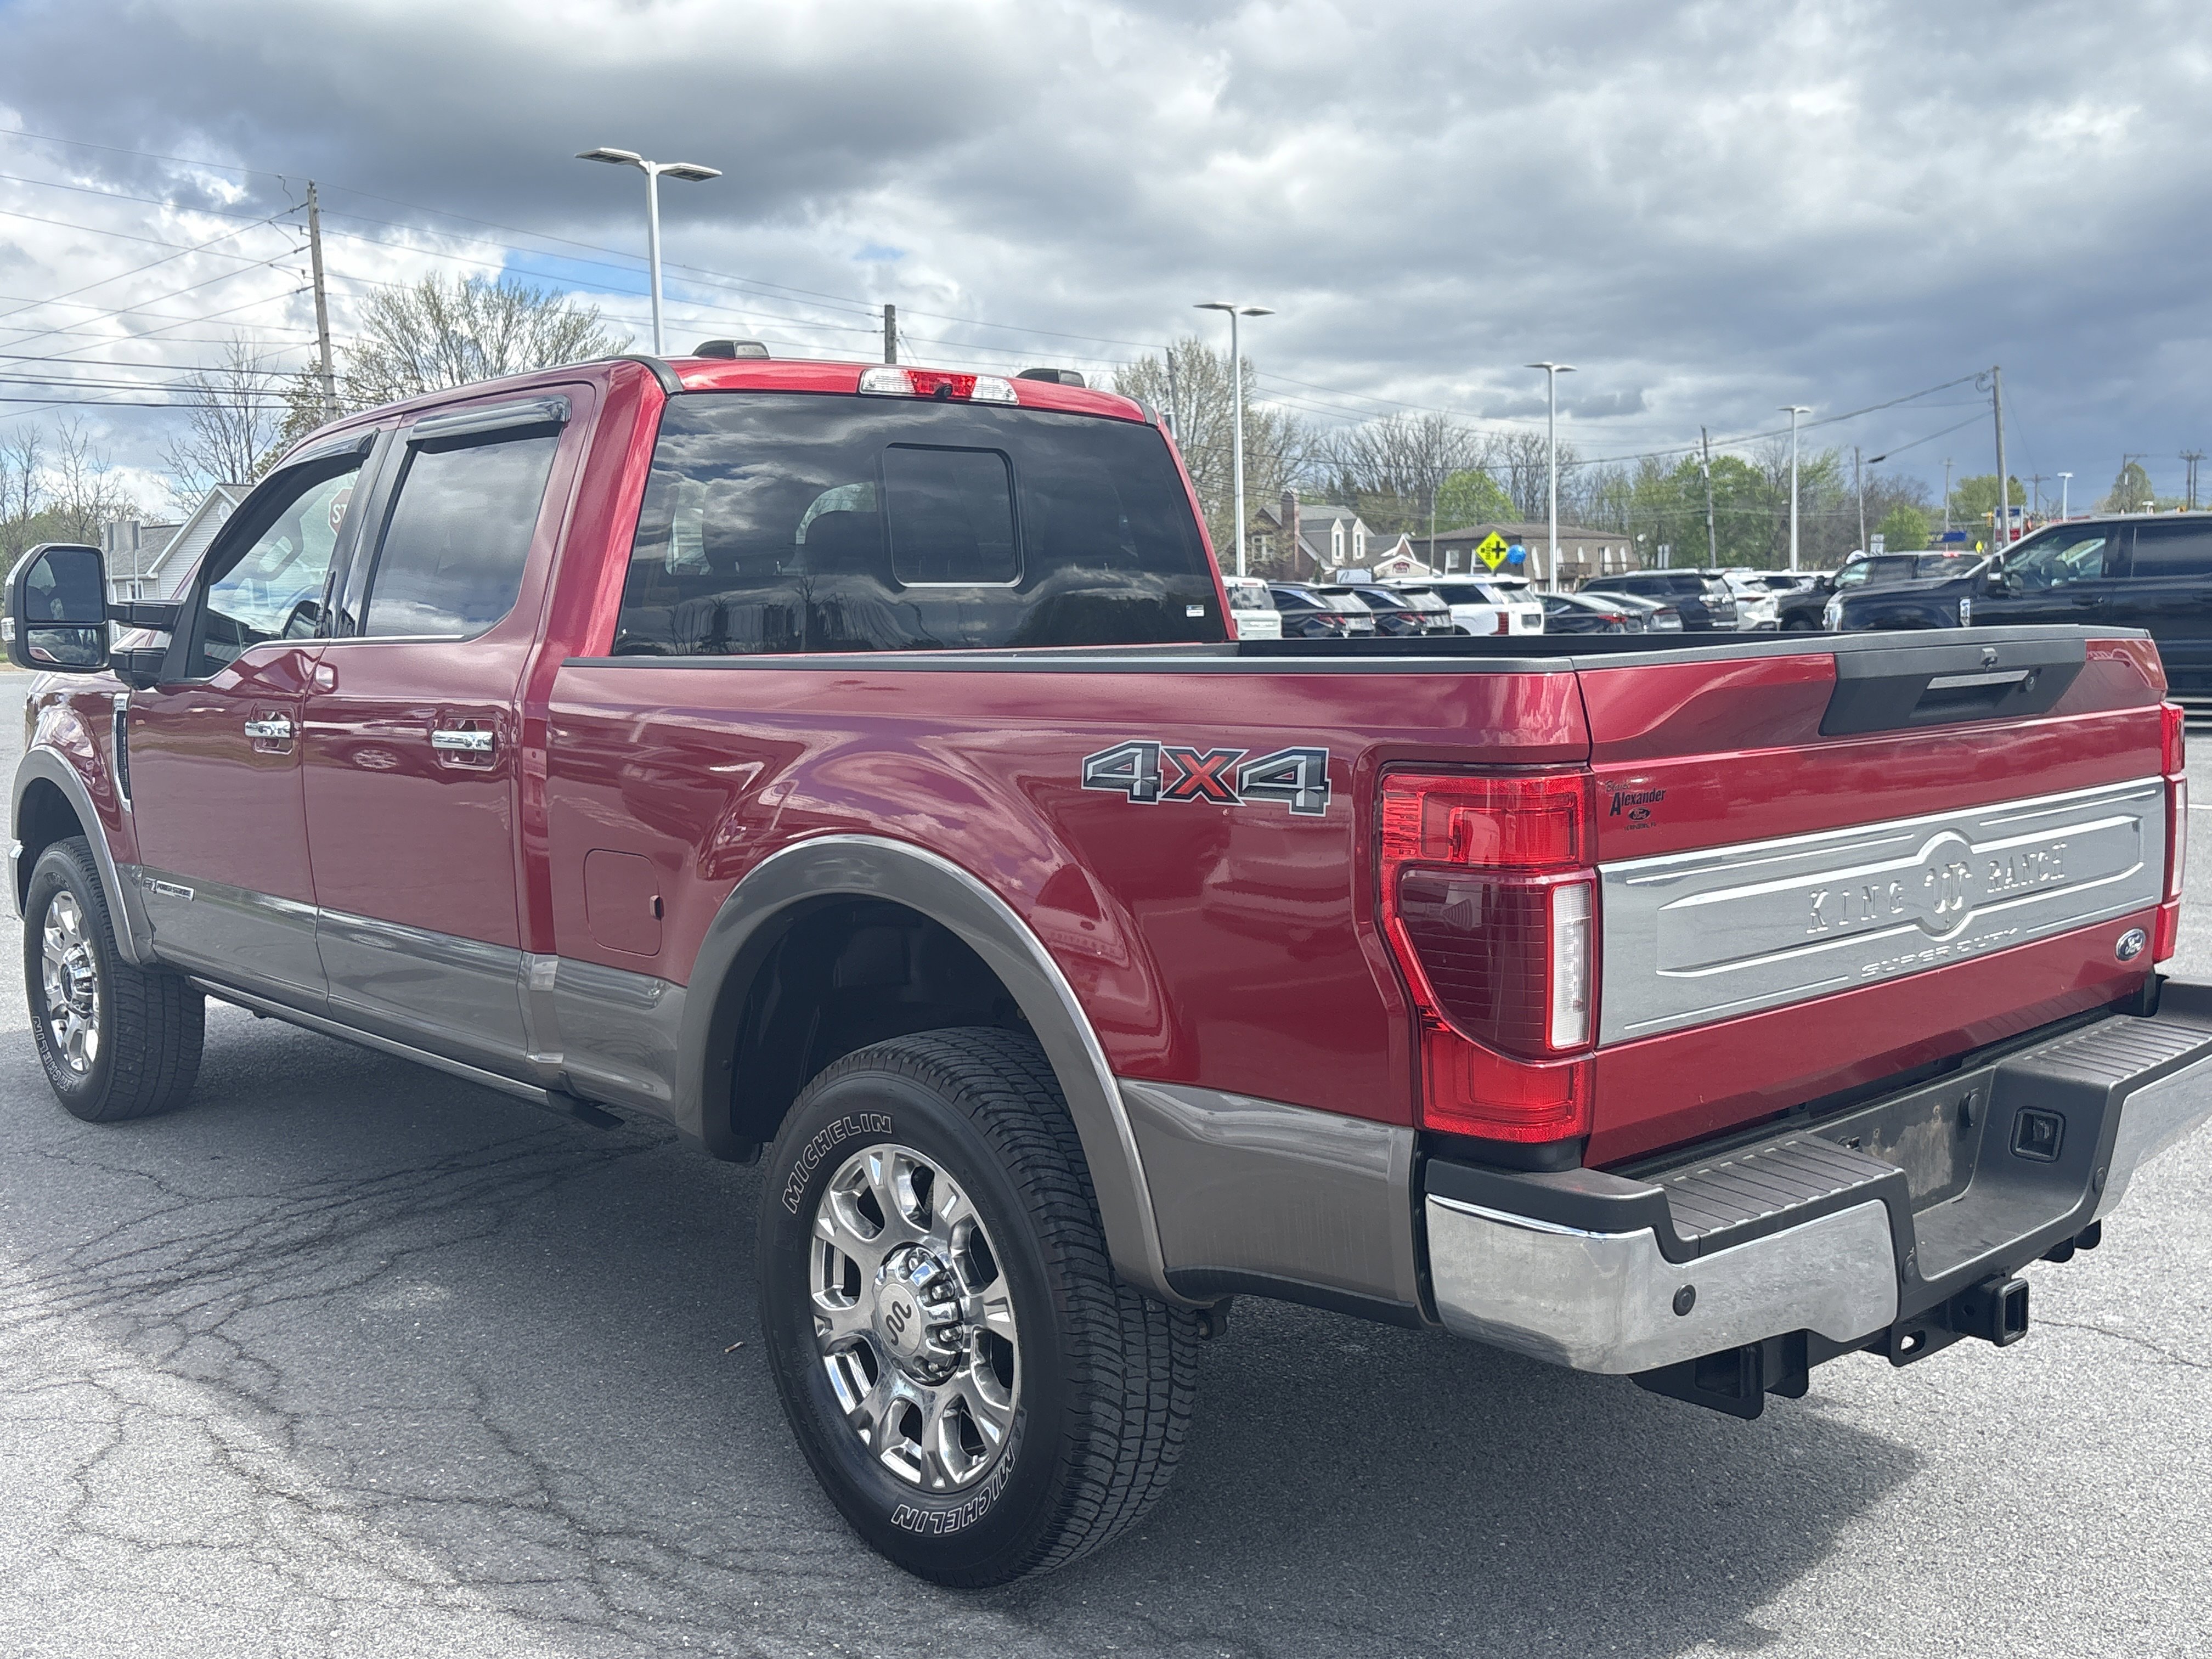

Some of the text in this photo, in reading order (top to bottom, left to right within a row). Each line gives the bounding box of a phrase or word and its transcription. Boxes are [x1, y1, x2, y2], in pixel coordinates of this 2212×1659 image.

[1609, 787, 1667, 817] Alexander
[1806, 842, 2068, 934] KING RANCH
[1861, 927, 2018, 978] SUPER DUTY
[32, 1015, 73, 1092] MICHELIN
[782, 1113, 893, 1215] MICHELIN
[890, 1441, 1016, 1534] MICHELIN
